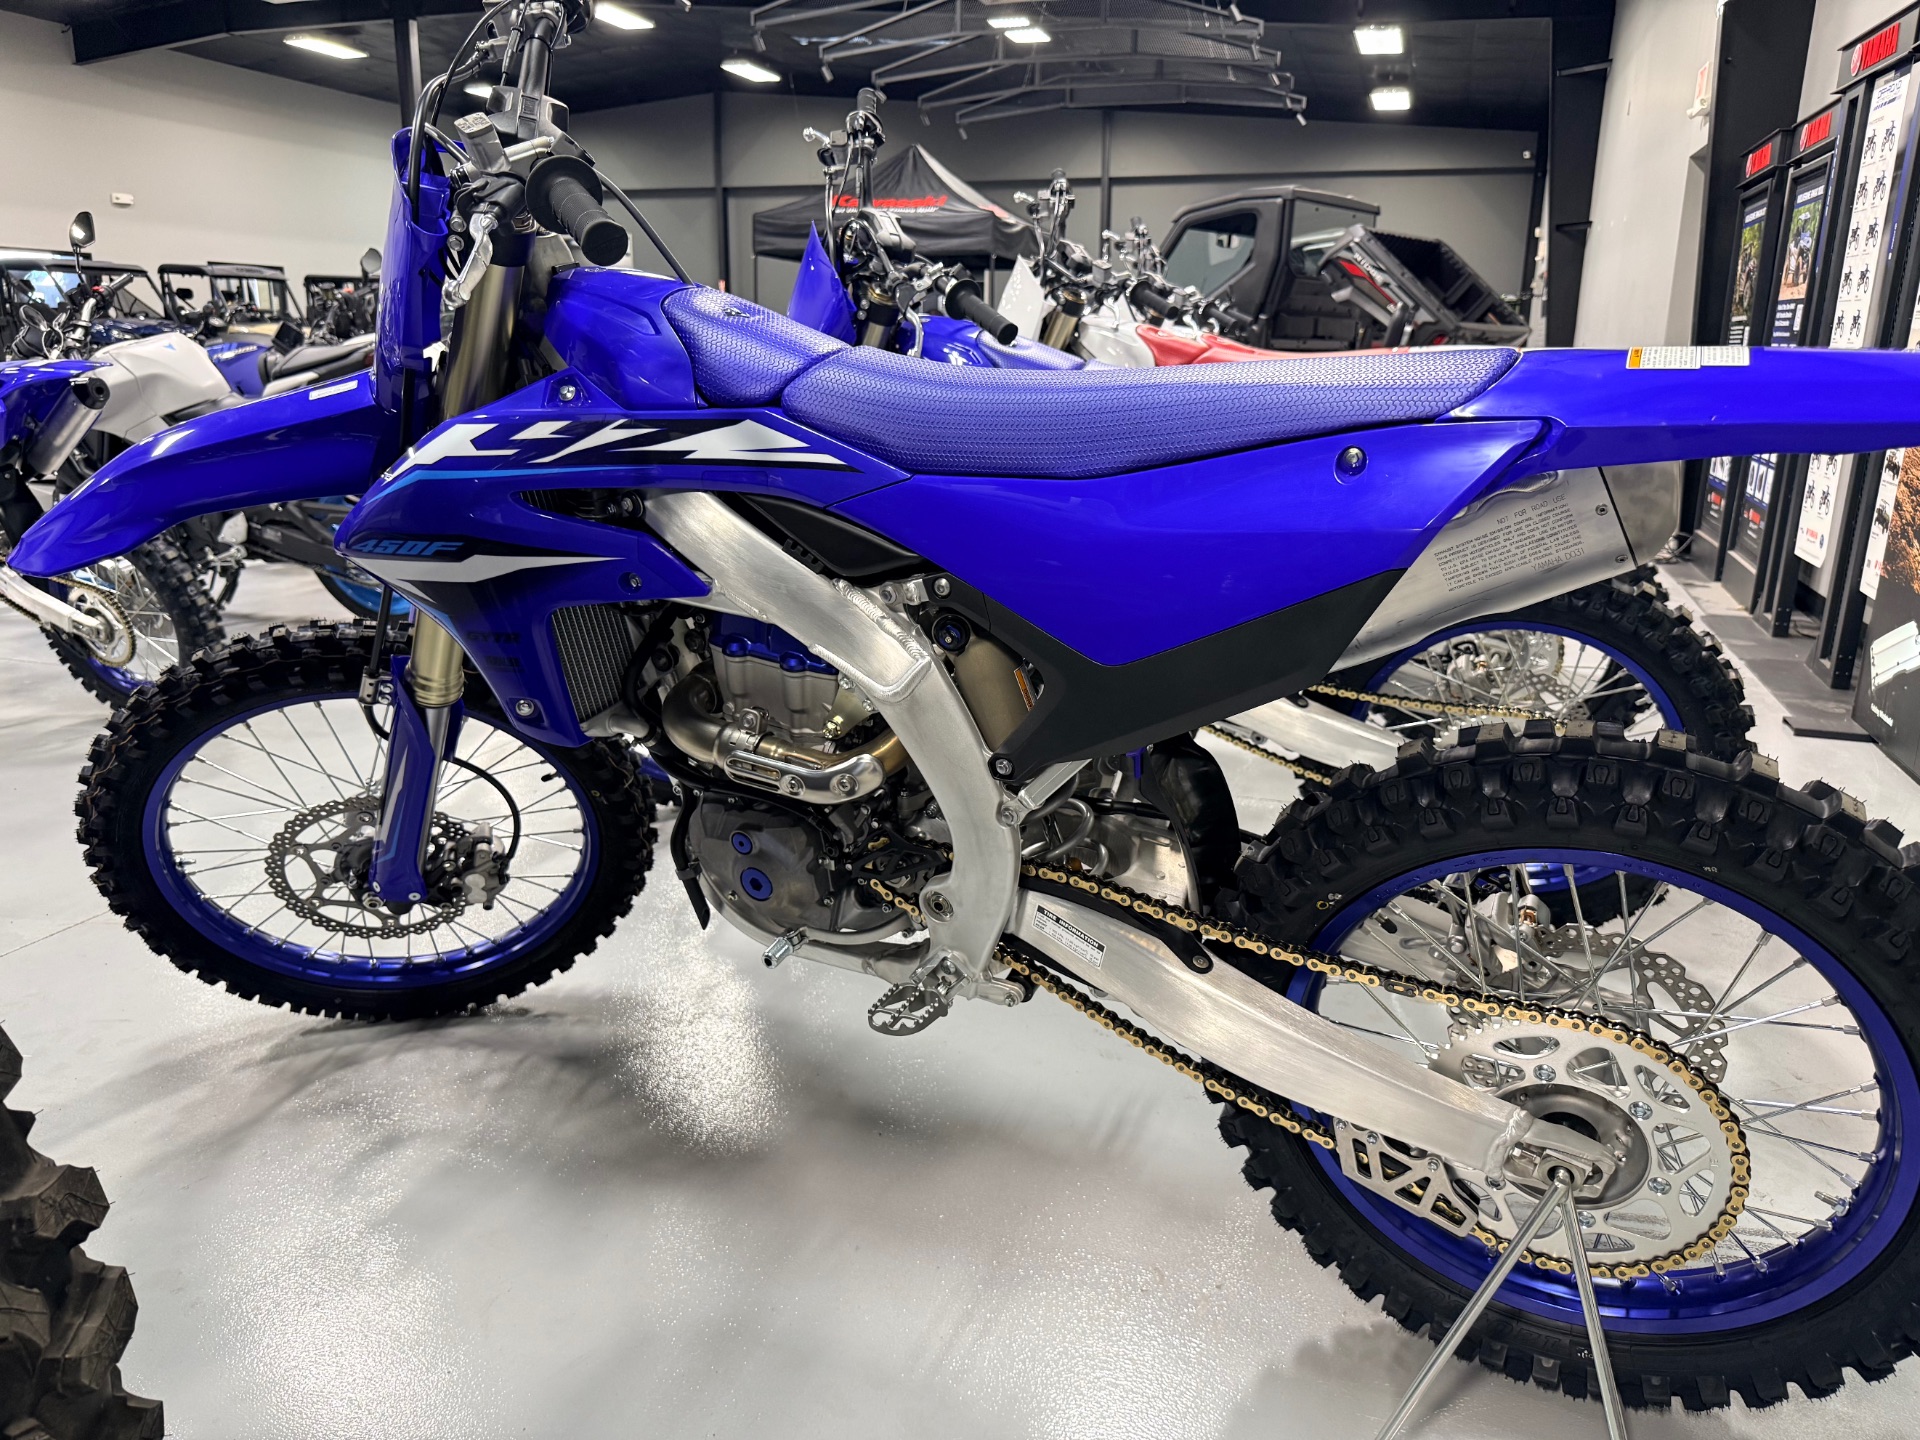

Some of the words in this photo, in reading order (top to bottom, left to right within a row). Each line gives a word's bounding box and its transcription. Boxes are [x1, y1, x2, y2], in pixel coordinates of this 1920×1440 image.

[1861, 22, 1900, 71] YAMAHA
[1496, 516, 1509, 525] NOT
[1514, 508, 1527, 518] FOR
[1531, 500, 1549, 512] ROAD
[1552, 494, 1566, 504] USE
[352, 540, 464, 556] 450F
[1531, 554, 1562, 572] YAMAHA
[1043, 909, 1056, 921] TIRE
[1058, 919, 1099, 948] INFORMATION
